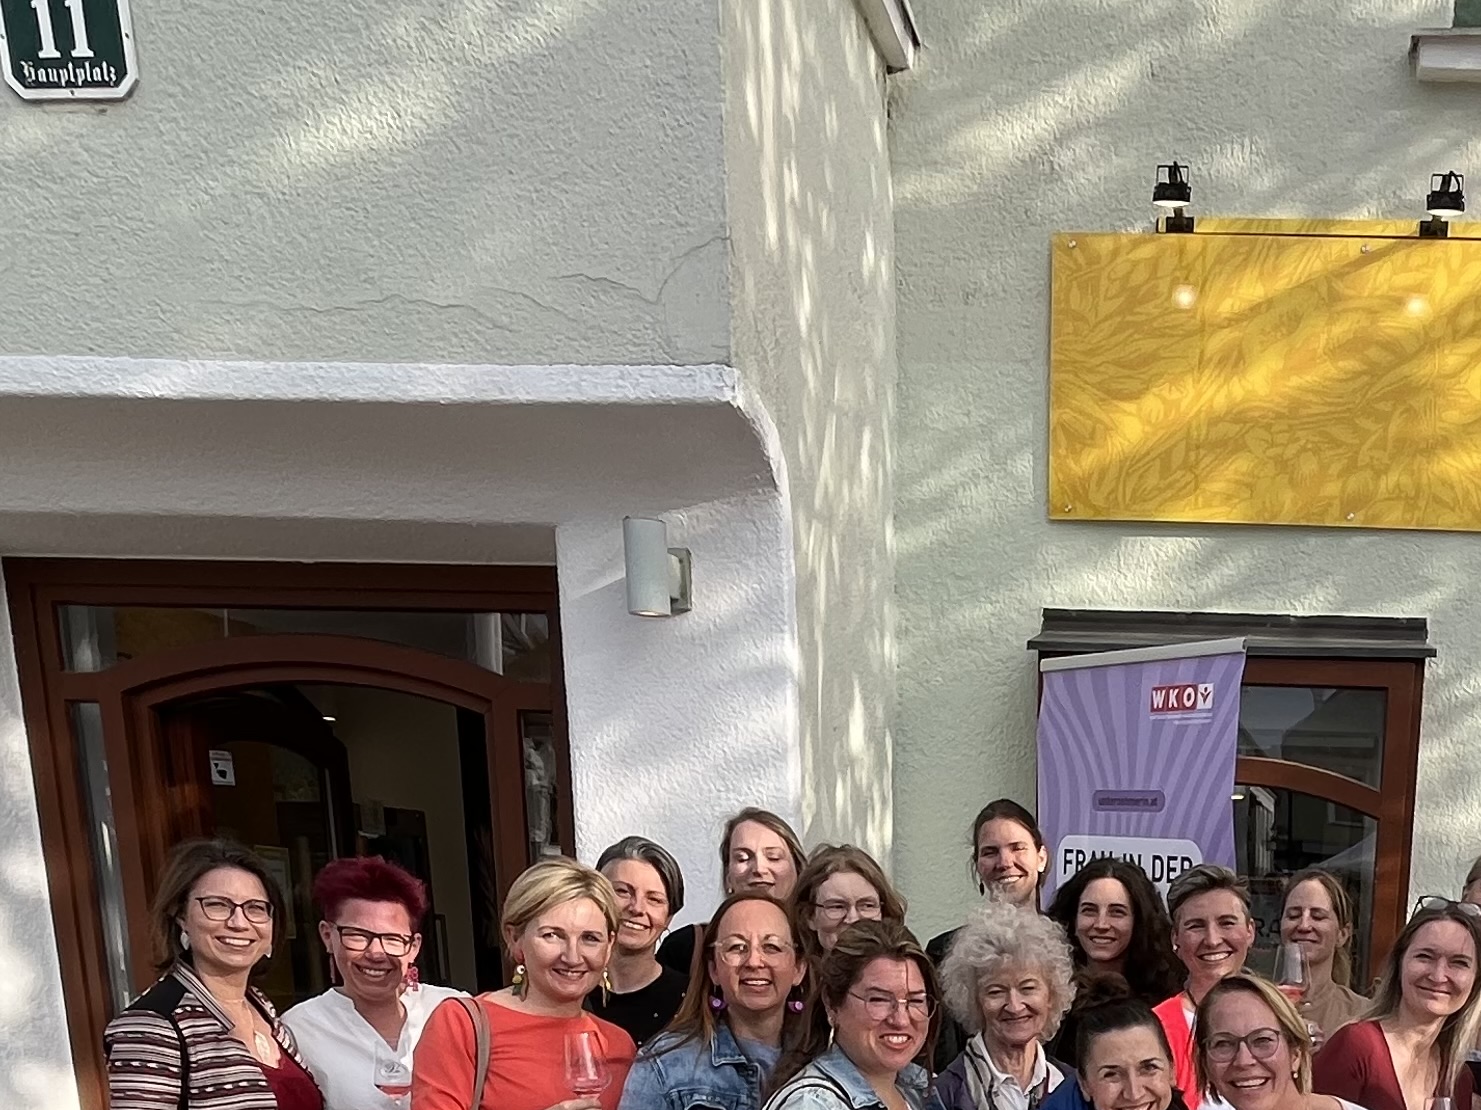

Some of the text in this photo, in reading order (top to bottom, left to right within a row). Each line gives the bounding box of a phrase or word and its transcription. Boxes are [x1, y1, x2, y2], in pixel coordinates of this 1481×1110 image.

[31, 0, 94, 58] 11
[20, 60, 117, 87] Hauptplatz
[1152, 687, 1195, 709] WKO
